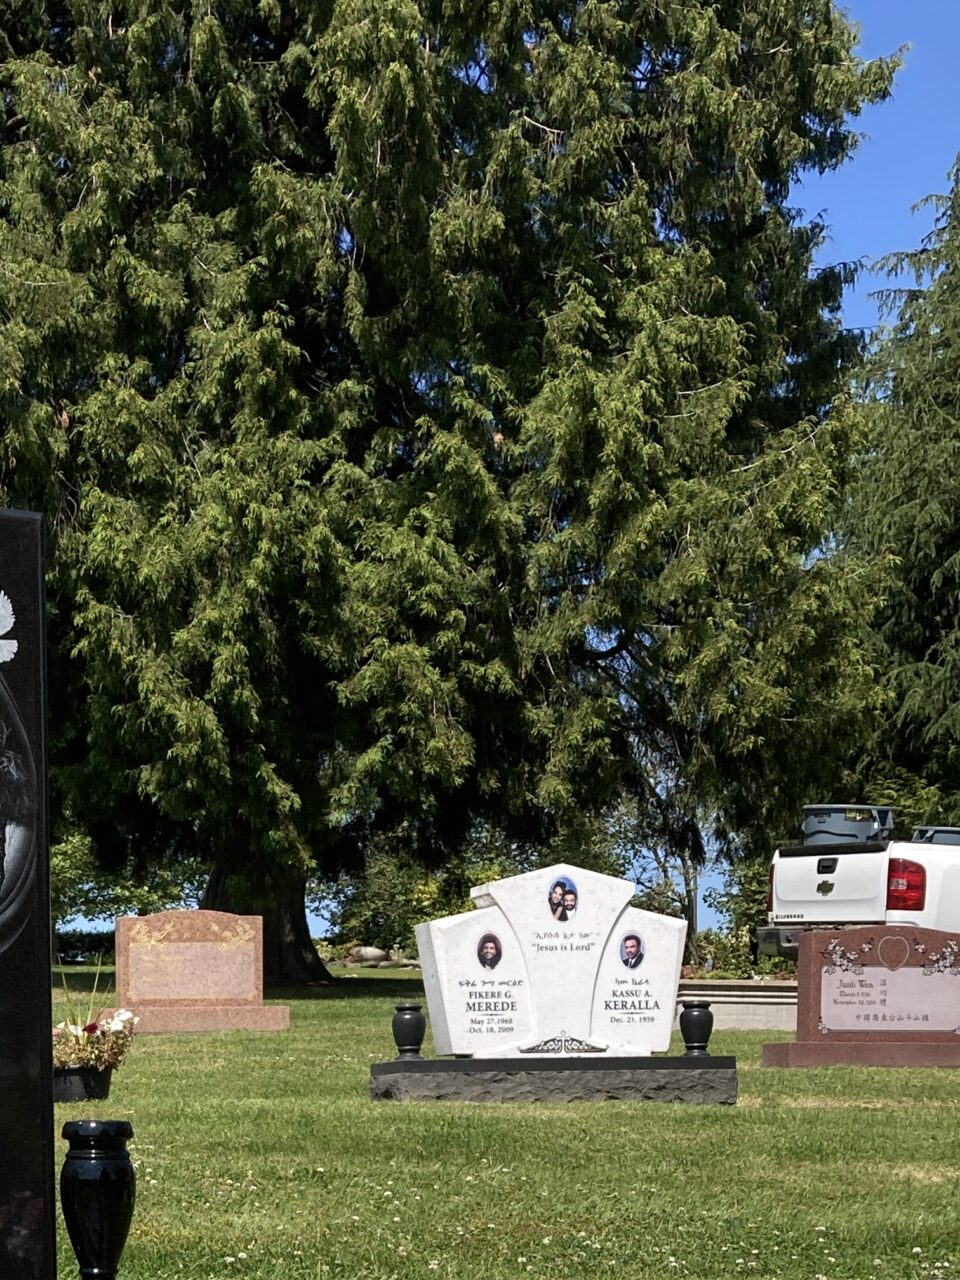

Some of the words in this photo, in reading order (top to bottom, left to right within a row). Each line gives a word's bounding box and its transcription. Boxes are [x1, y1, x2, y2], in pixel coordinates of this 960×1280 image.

[468, 991, 502, 999] FIKERE
[612, 989, 642, 998] KASSU
[644, 989, 653, 998] A.
[466, 1001, 518, 1012] MEREDE
[604, 1000, 661, 1011] KERALLA
